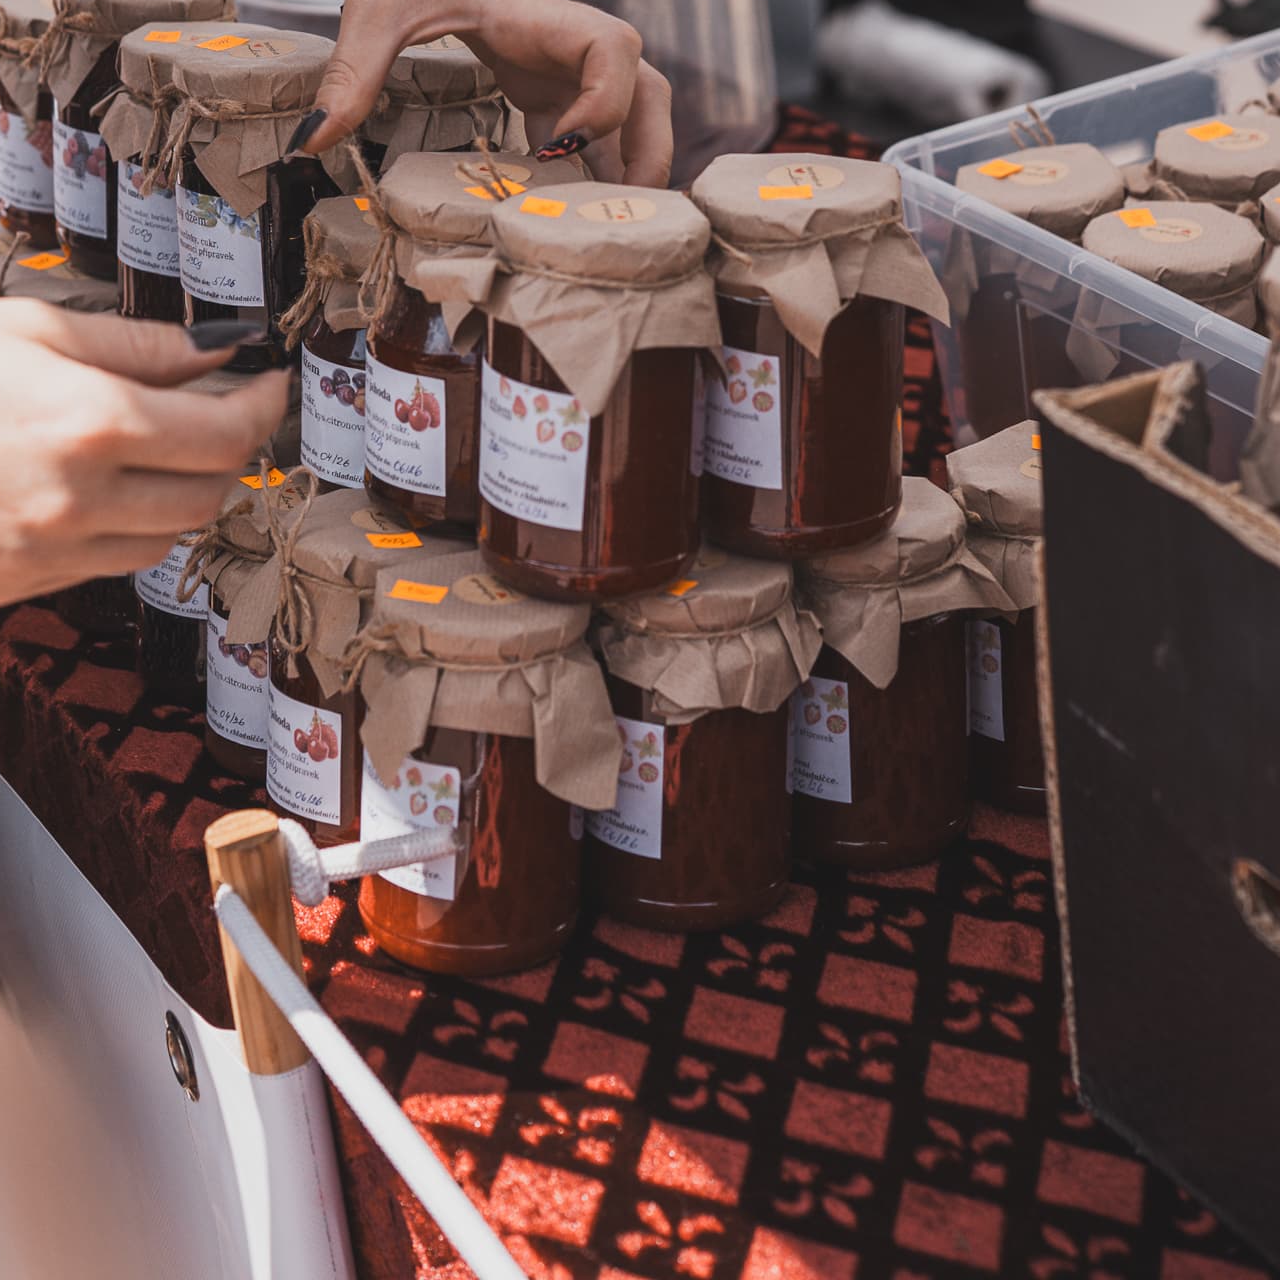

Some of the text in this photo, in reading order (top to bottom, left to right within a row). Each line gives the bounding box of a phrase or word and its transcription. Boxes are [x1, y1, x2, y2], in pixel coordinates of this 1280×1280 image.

[184, 209, 209, 227] džem
[200, 238, 219, 249] cukr,
[212, 275, 237, 288] 5/26
[320, 451, 350, 468] 04/26
[295, 791, 323, 806] 06/26
